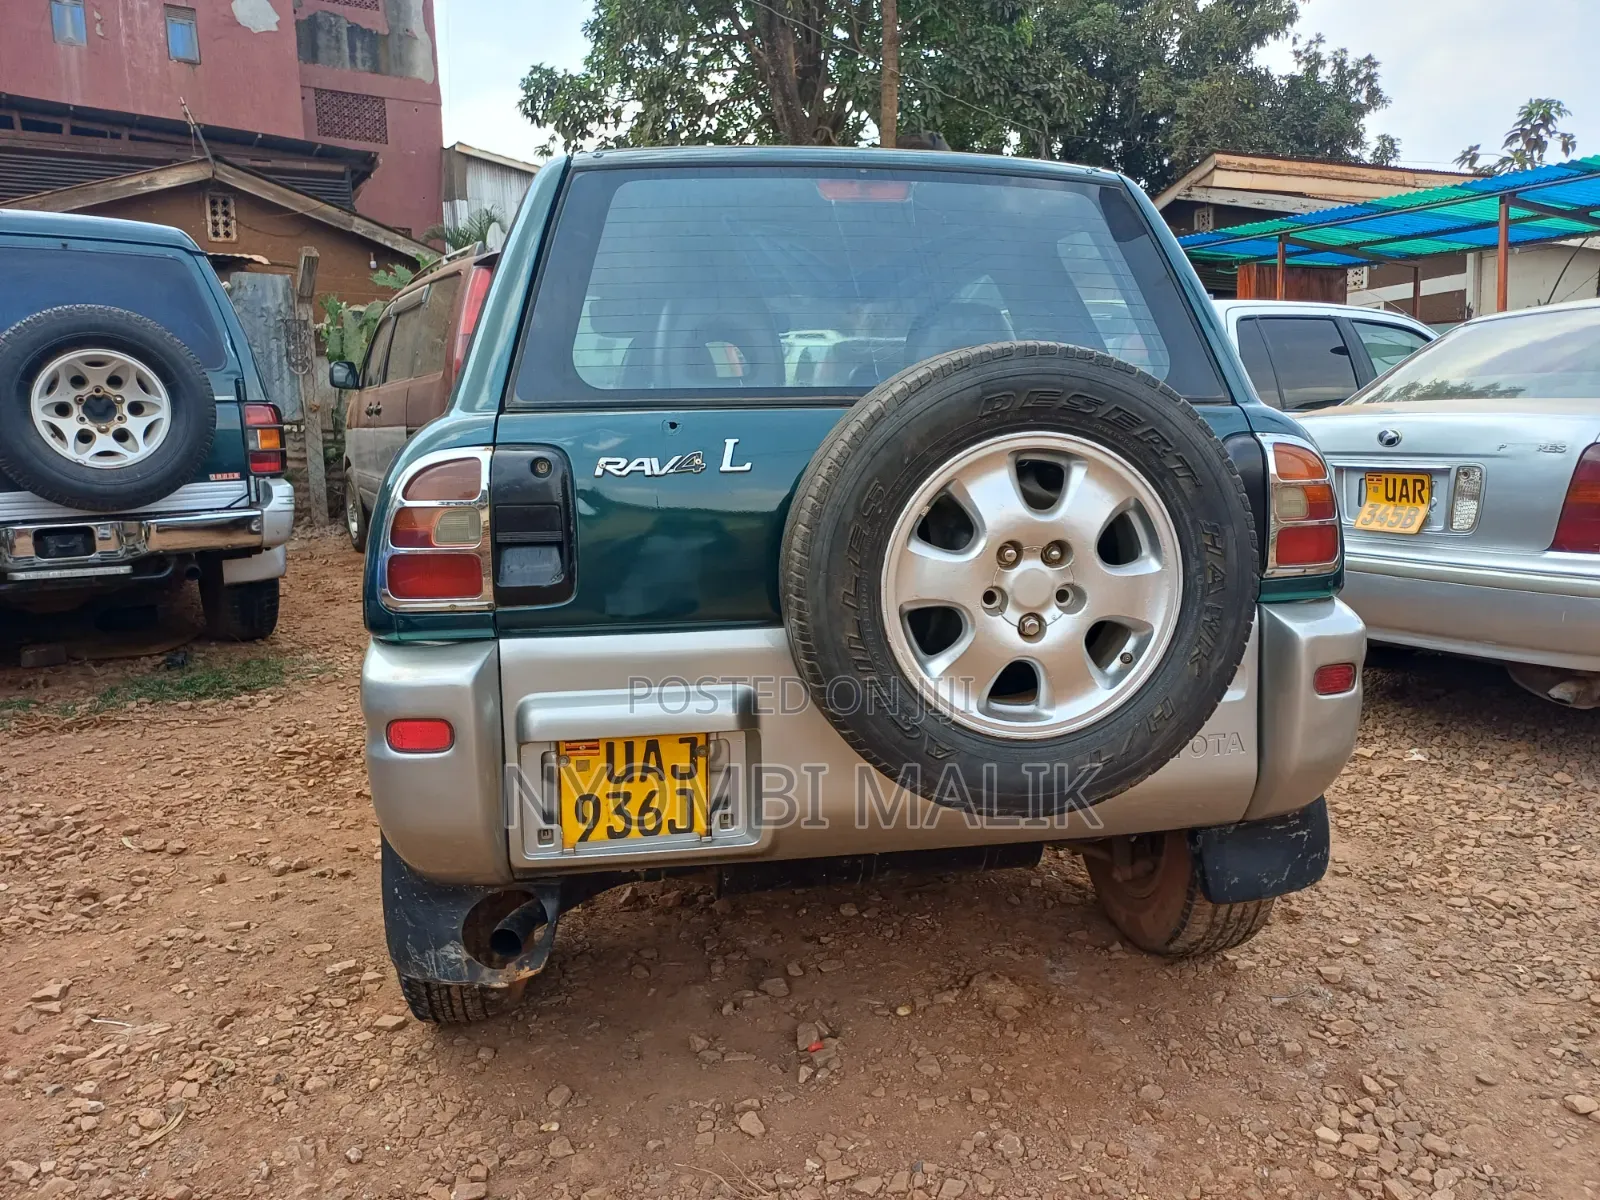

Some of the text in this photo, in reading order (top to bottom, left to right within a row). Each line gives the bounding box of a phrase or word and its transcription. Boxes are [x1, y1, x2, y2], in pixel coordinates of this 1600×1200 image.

[594, 438, 752, 478] RAV4 L
[1384, 477, 1426, 504] UAR
[978, 388, 1203, 488] DESERT
[1187, 519, 1228, 678] HAWK
[1360, 503, 1420, 529] 345B
[605, 736, 699, 785] UAJ
[1176, 731, 1247, 760] OTA
[574, 787, 696, 843] 936J
